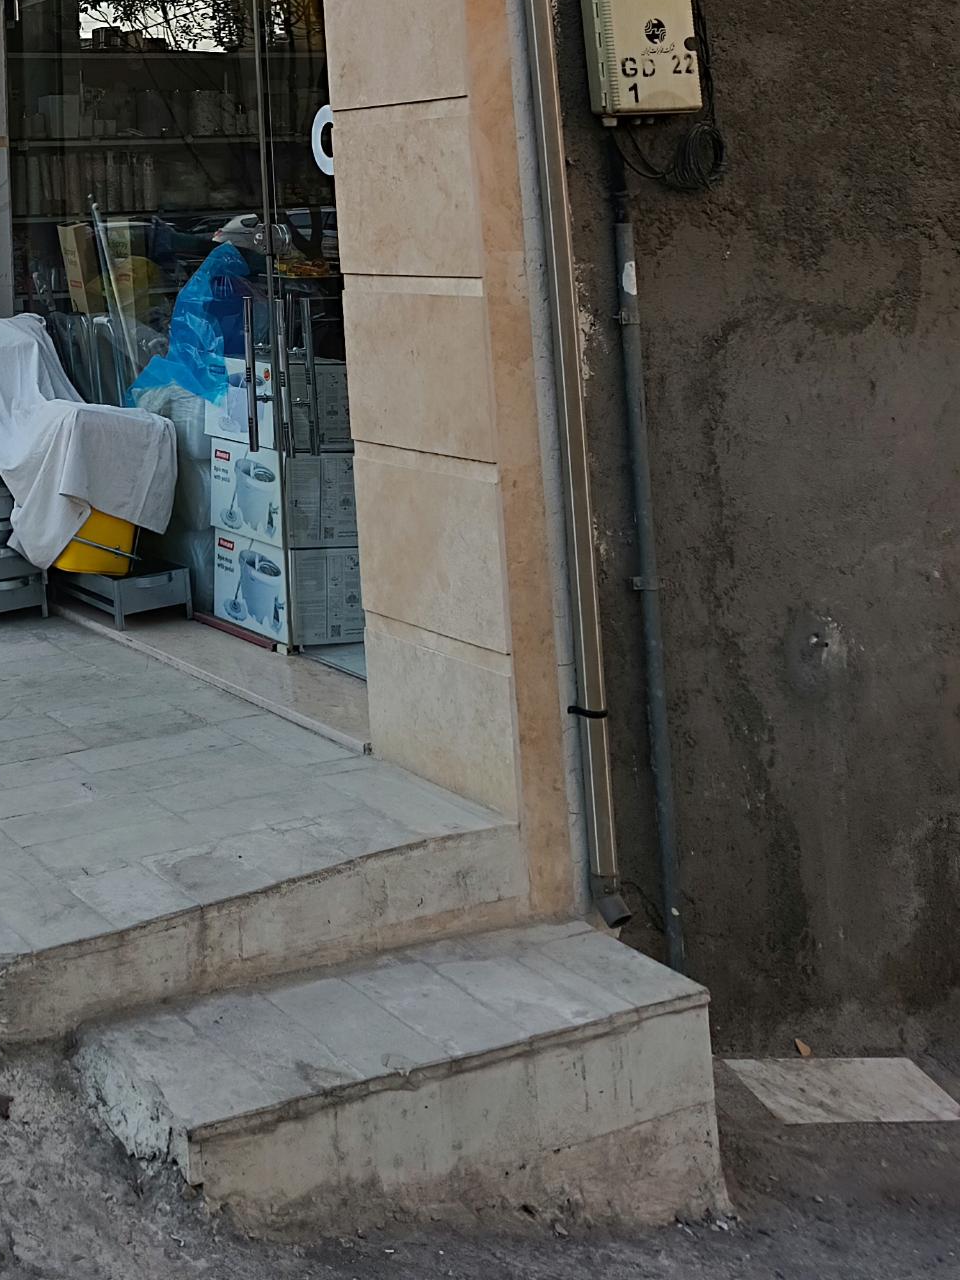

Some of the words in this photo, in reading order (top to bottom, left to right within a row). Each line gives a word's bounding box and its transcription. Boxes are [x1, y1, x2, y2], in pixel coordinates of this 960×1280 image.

[621, 57, 656, 78] GD
[672, 53, 694, 74] 22
[628, 82, 639, 103] 1
